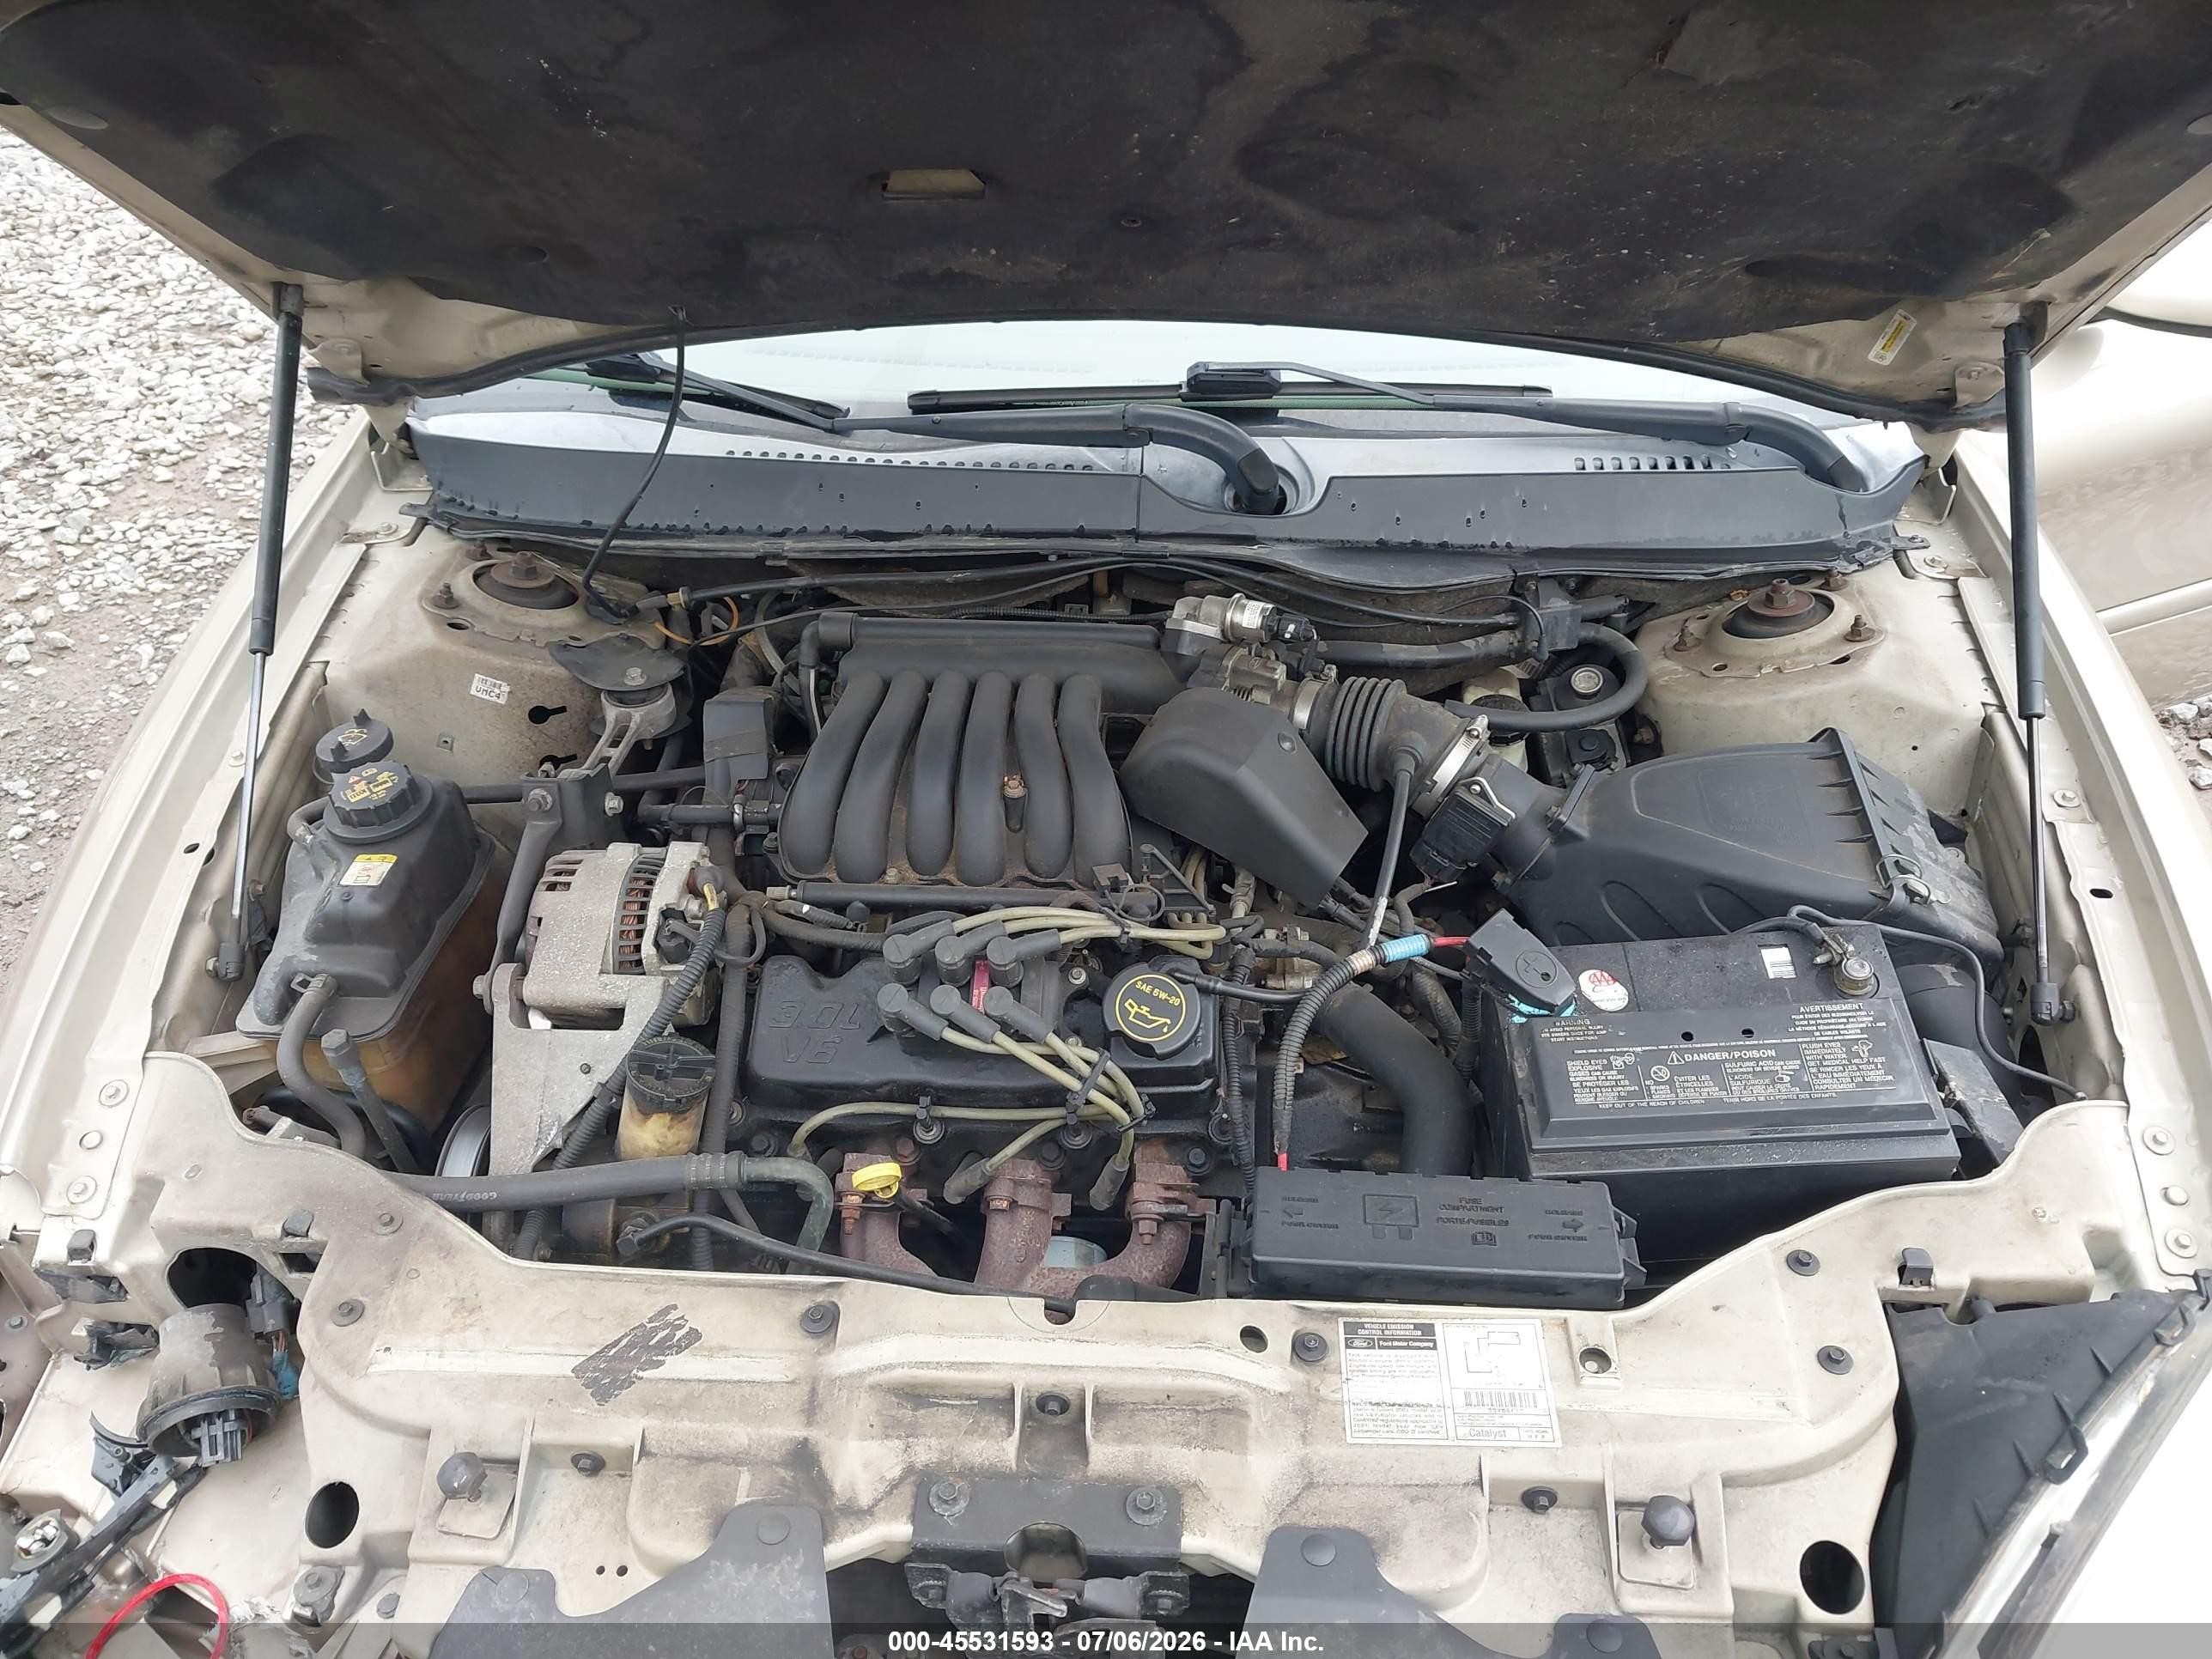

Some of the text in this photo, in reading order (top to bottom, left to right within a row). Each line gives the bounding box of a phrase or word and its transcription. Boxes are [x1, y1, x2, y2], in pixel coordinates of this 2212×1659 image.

[1135, 981, 1180, 1006] SAE 5W-20
[1800, 1003, 1863, 1013] AVERTISSEMENT
[781, 1033, 843, 1064] V6
[1684, 1049, 1776, 1062] DANGER/POISON
[432, 1191, 497, 1202] GOODYEAR
[1469, 1428, 1507, 1439] Catalyst
